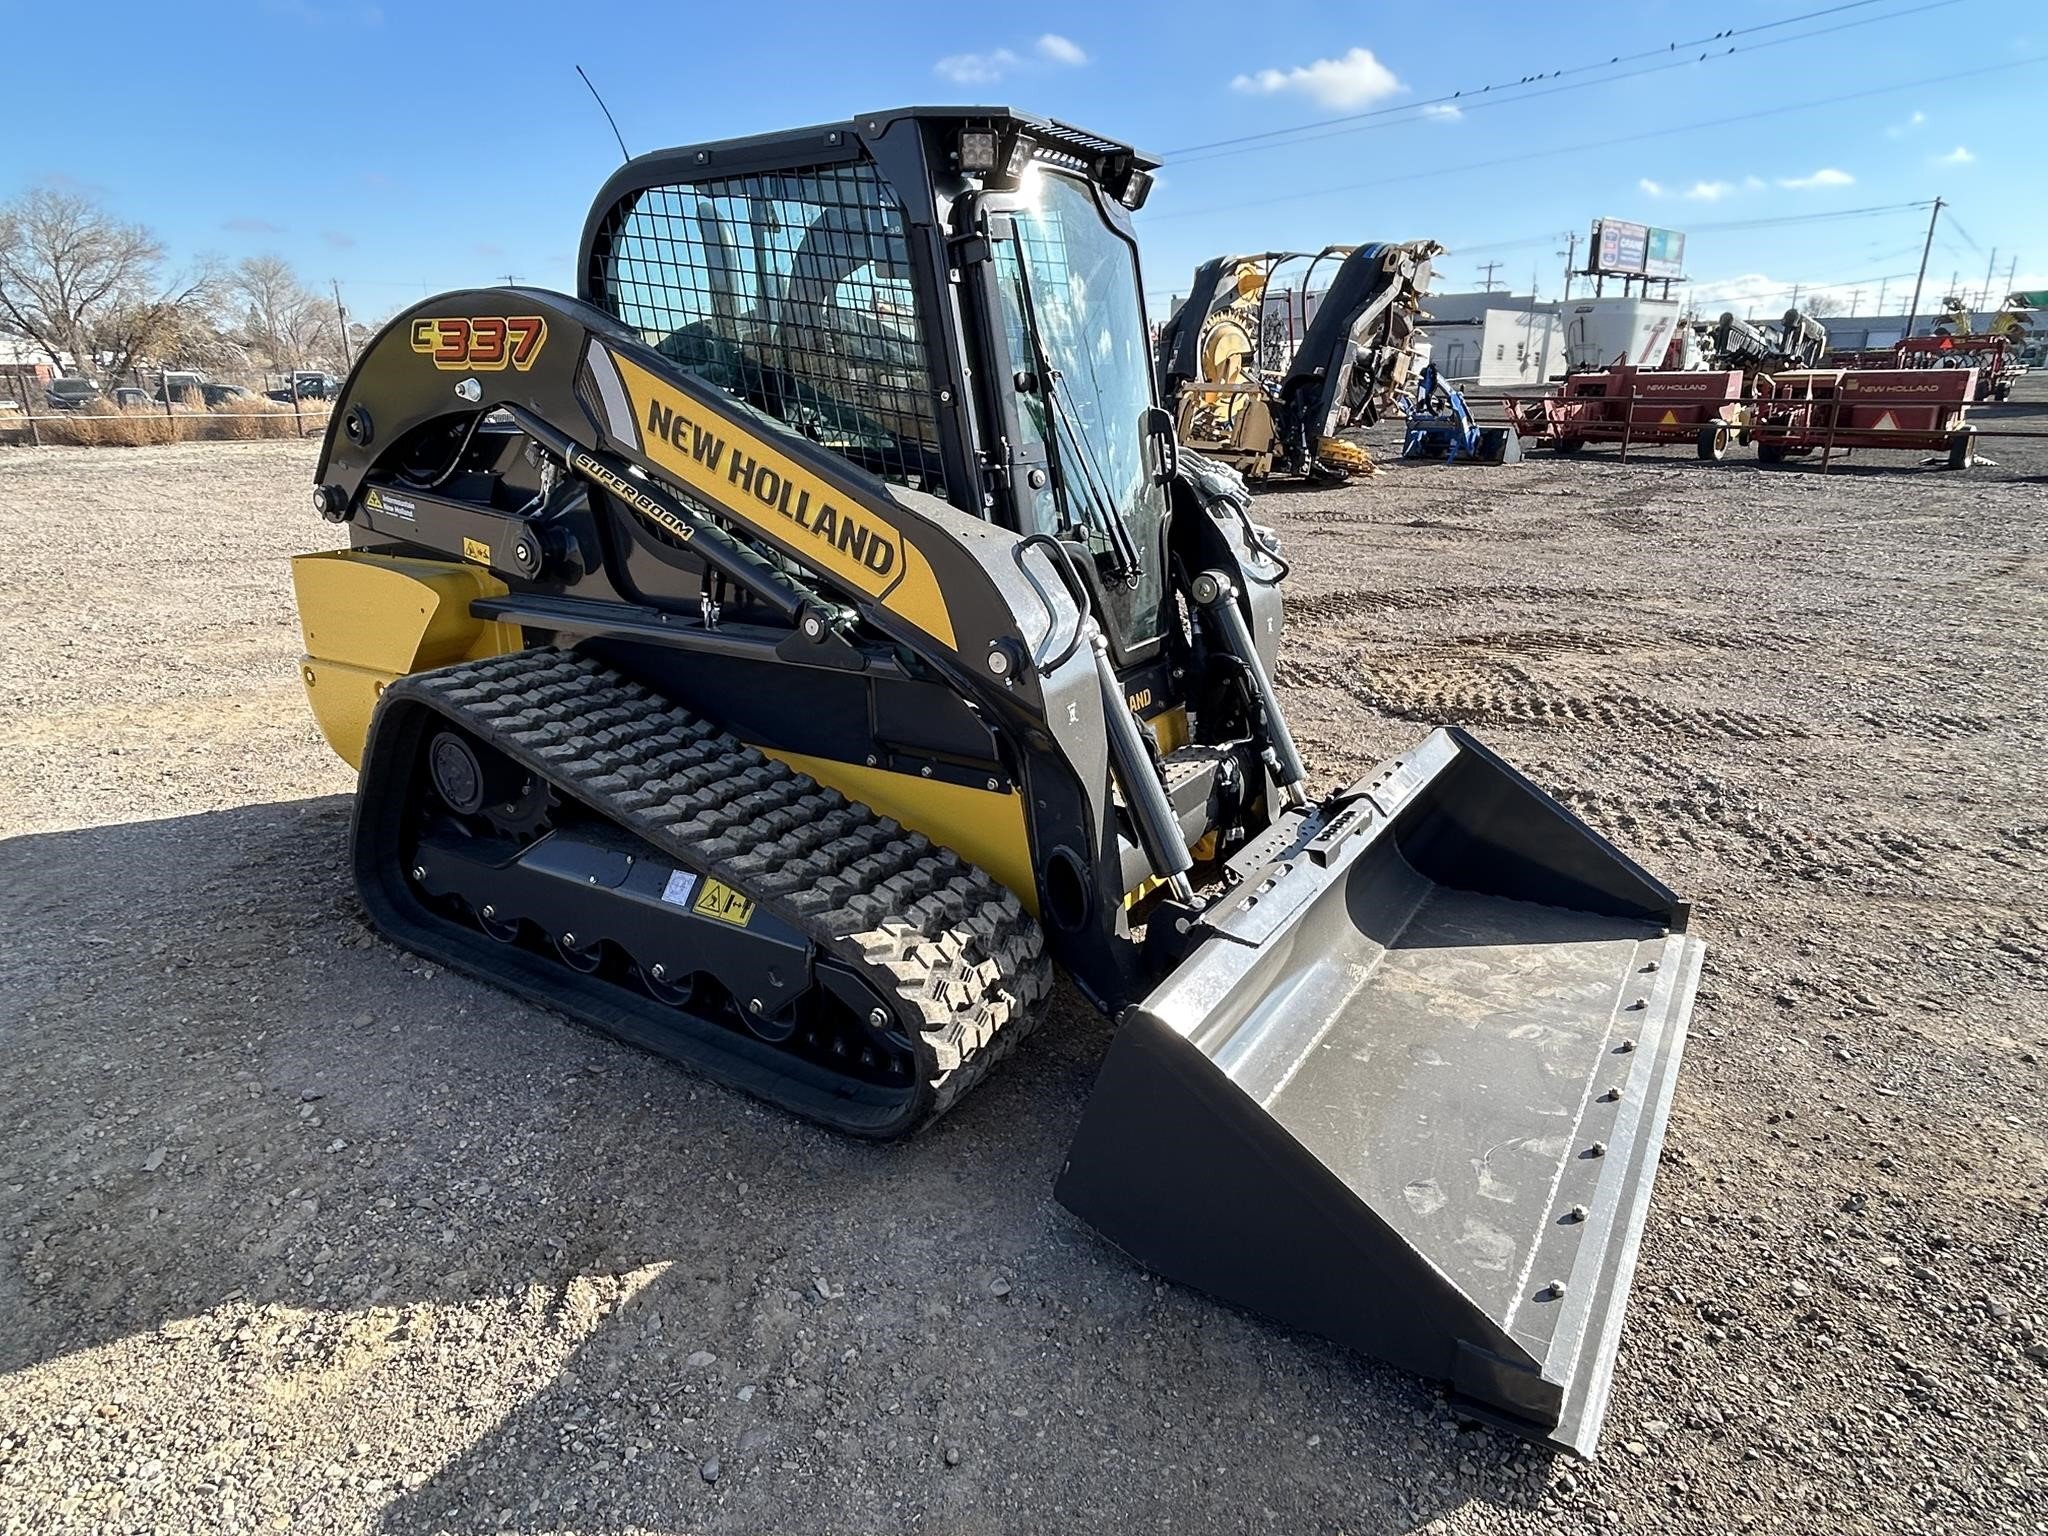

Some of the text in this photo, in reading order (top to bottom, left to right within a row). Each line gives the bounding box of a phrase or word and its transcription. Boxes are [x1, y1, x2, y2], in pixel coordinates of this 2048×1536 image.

[575, 453, 694, 542] SUPER BOOM
[647, 399, 895, 577] NEW HOLLAND
